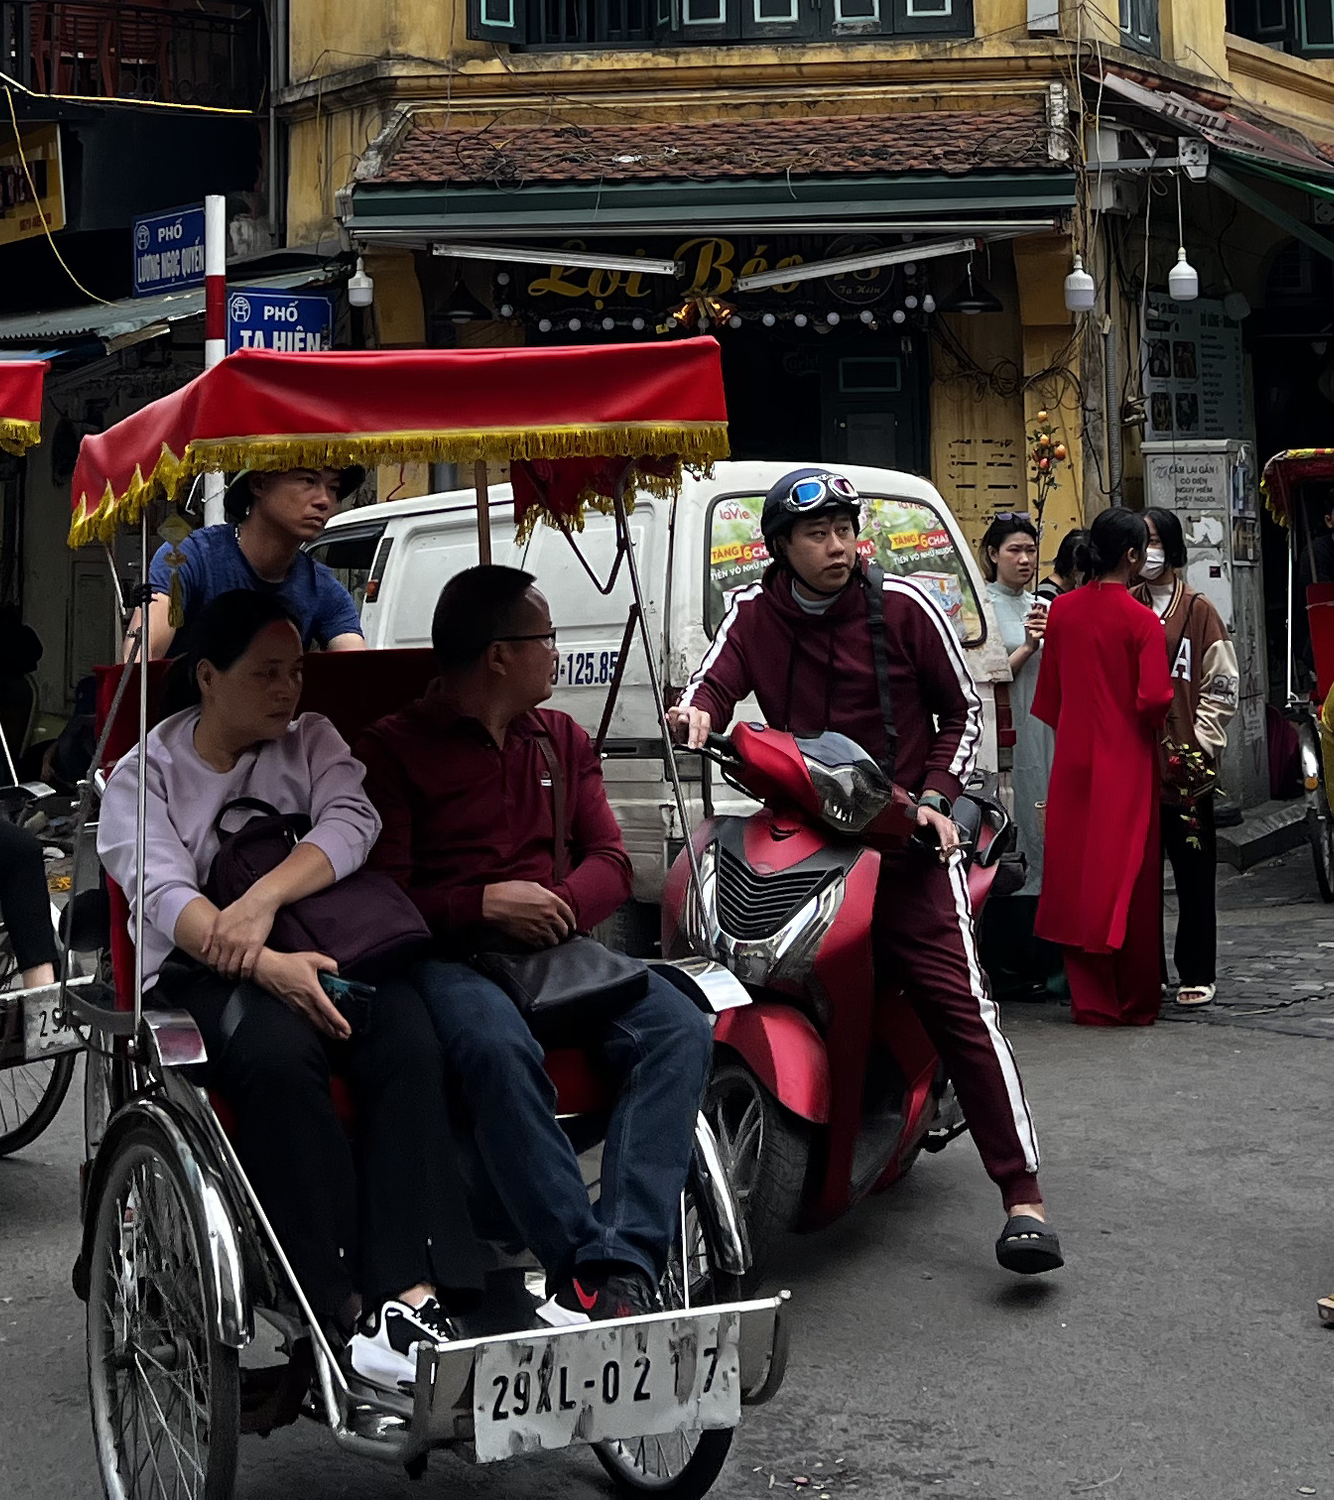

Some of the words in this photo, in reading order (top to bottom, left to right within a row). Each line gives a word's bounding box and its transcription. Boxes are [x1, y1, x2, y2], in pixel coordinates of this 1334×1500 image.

[157, 217, 183, 243] PHỐ
[161, 249, 180, 283] NGỌC
[263, 300, 299, 322] PHỐ
[752, 545, 769, 558] CH
[1170, 637, 1192, 682] A
